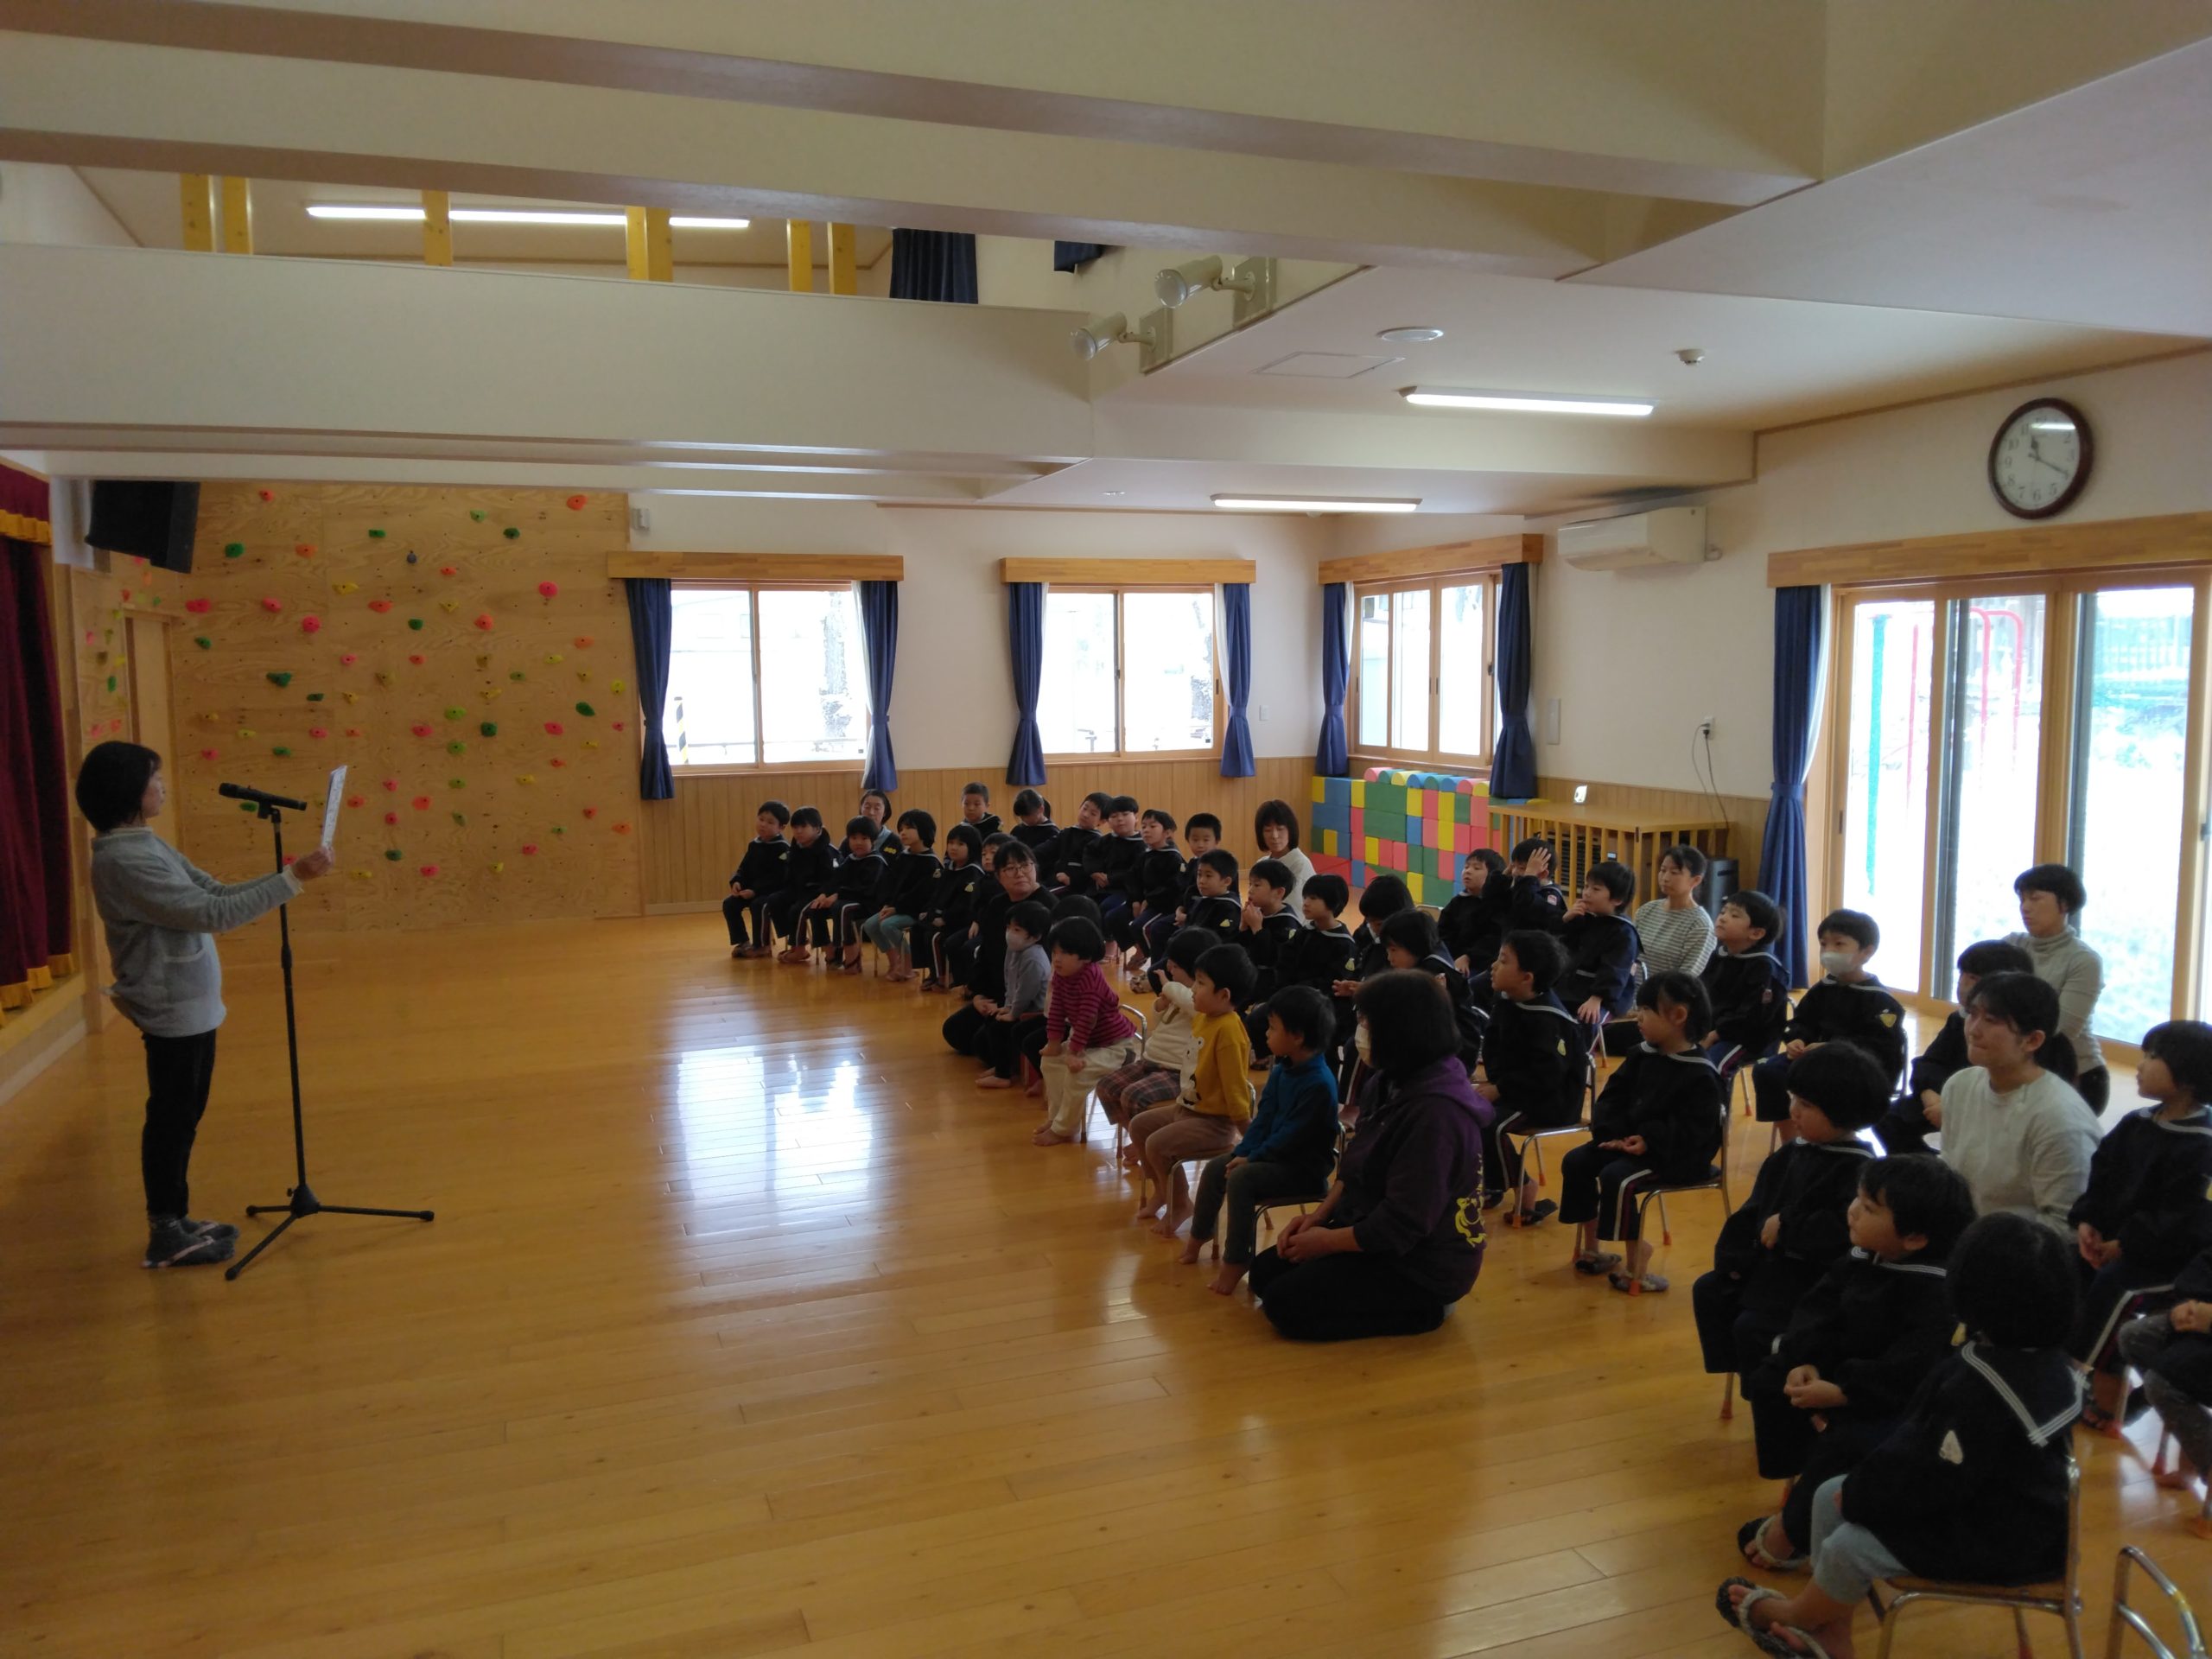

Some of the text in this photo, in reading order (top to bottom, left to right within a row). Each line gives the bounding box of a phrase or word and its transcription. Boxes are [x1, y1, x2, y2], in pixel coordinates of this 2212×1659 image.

[2063, 431, 2072, 444] 2
[2008, 439, 2019, 451] 10
[2005, 456, 2012, 467] 9
[2007, 474, 2016, 486] 8
[2018, 486, 2026, 499] 7
[2049, 482, 2057, 495] 5
[2033, 489, 2042, 501] 6
